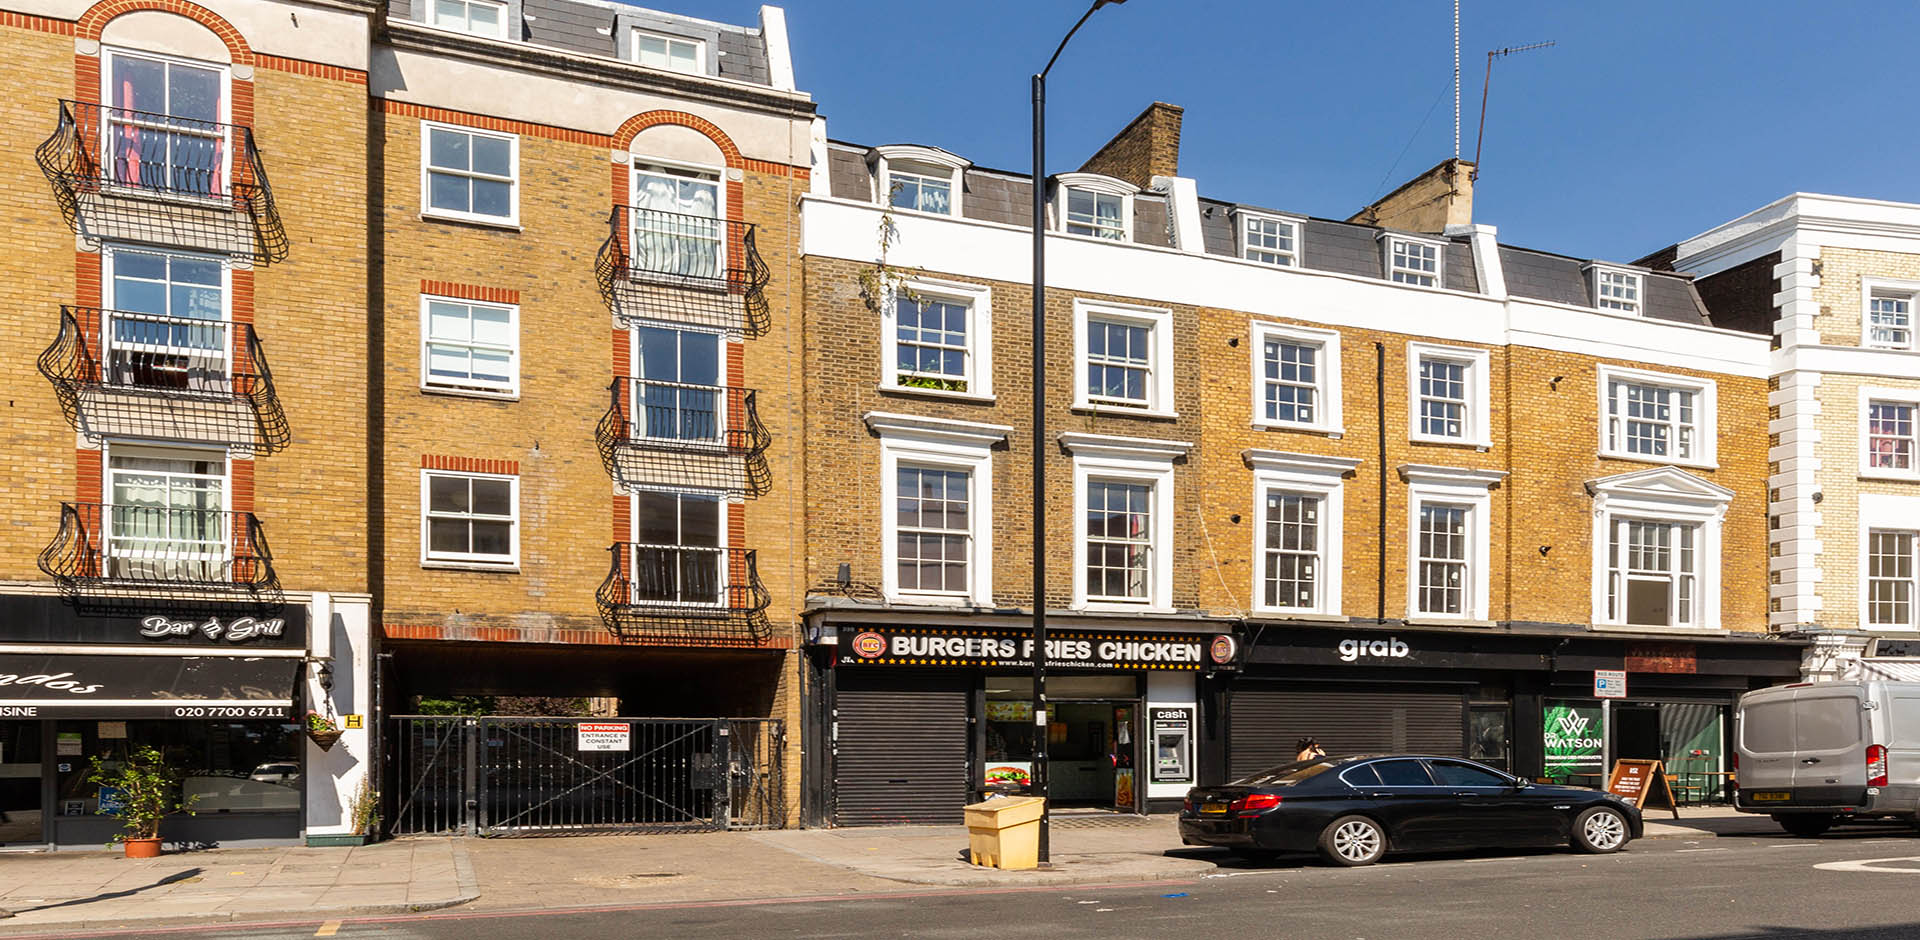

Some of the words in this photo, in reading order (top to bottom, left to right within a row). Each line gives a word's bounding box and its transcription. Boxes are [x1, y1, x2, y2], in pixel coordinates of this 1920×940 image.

[141, 616, 195, 636] Bar
[226, 616, 284, 640] Grill
[892, 636, 1016, 658] BURGERS
[1022, 639, 1092, 660] FRIES
[1098, 642, 1201, 662] CHICKEN
[1339, 637, 1409, 661] grab
[998, 660, 1113, 669] www.burgsfrieschicken.com
[175, 707, 204, 717] 020
[208, 707, 245, 717] 7700
[248, 707, 284, 717] 6711
[1157, 710, 1187, 719] cash
[1544, 738, 1602, 748] WATSON
